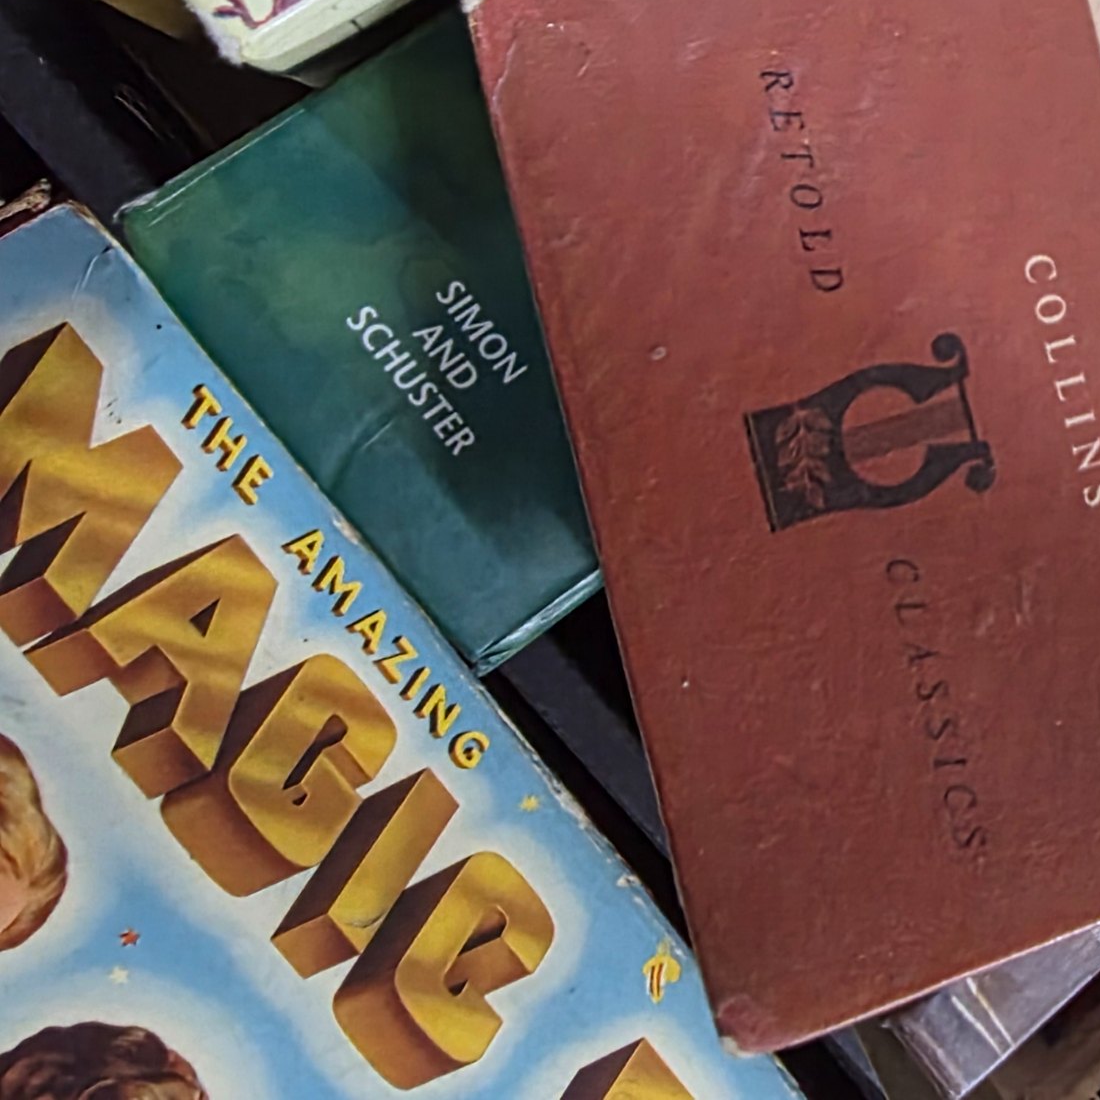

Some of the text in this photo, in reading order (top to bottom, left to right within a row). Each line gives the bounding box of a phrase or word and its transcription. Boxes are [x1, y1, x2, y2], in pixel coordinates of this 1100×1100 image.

[759, 70, 846, 295] RETOLD
[345, 304, 476, 456] SCHUSTER
[410, 324, 479, 390] AND
[435, 280, 529, 385] SIMON
[180, 383, 490, 770] THE AMAZING
[0, 321, 555, 1090] MAGIC
[886, 557, 988, 856] CLASSICS
